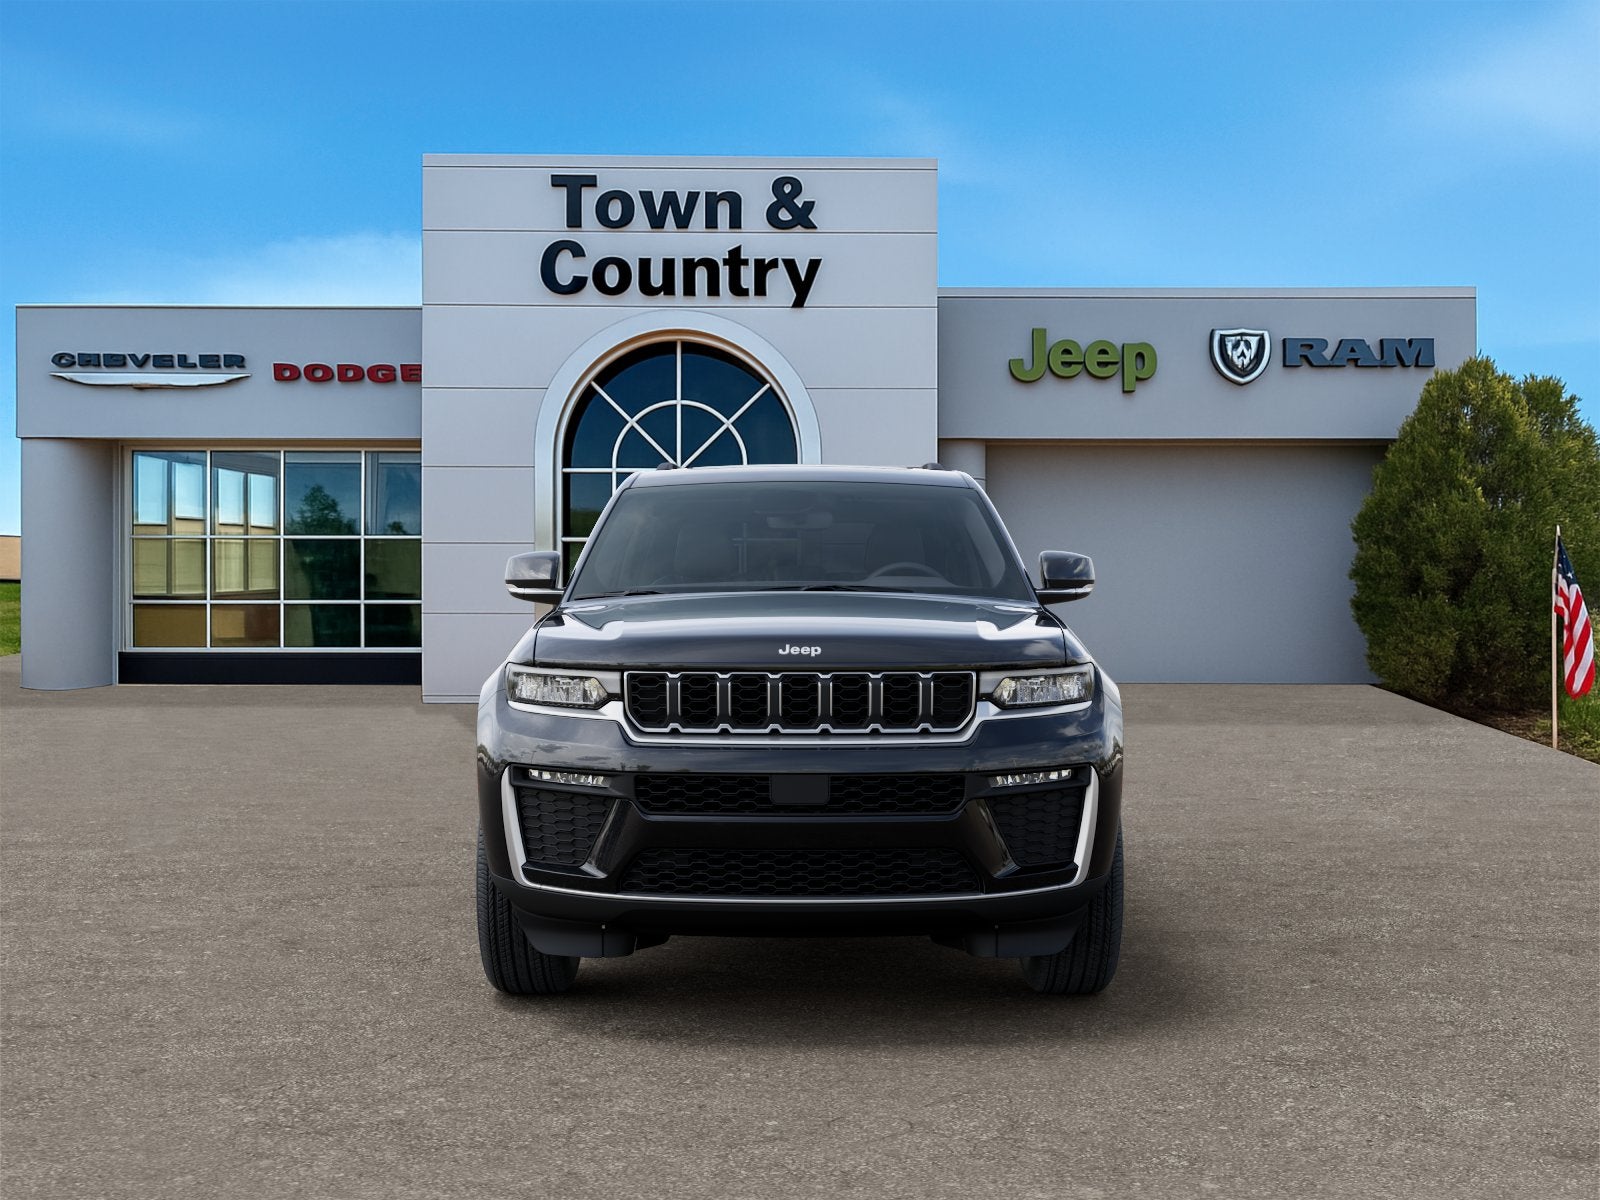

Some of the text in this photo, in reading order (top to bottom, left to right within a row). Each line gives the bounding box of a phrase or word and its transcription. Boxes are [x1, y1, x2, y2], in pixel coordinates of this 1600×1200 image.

[551, 174, 818, 229] Town &
[540, 239, 823, 308] Country
[272, 362, 422, 384] DODGE
[1008, 328, 1158, 393] Jeep
[1283, 337, 1436, 368] RAM
[778, 643, 822, 657] Jeep
